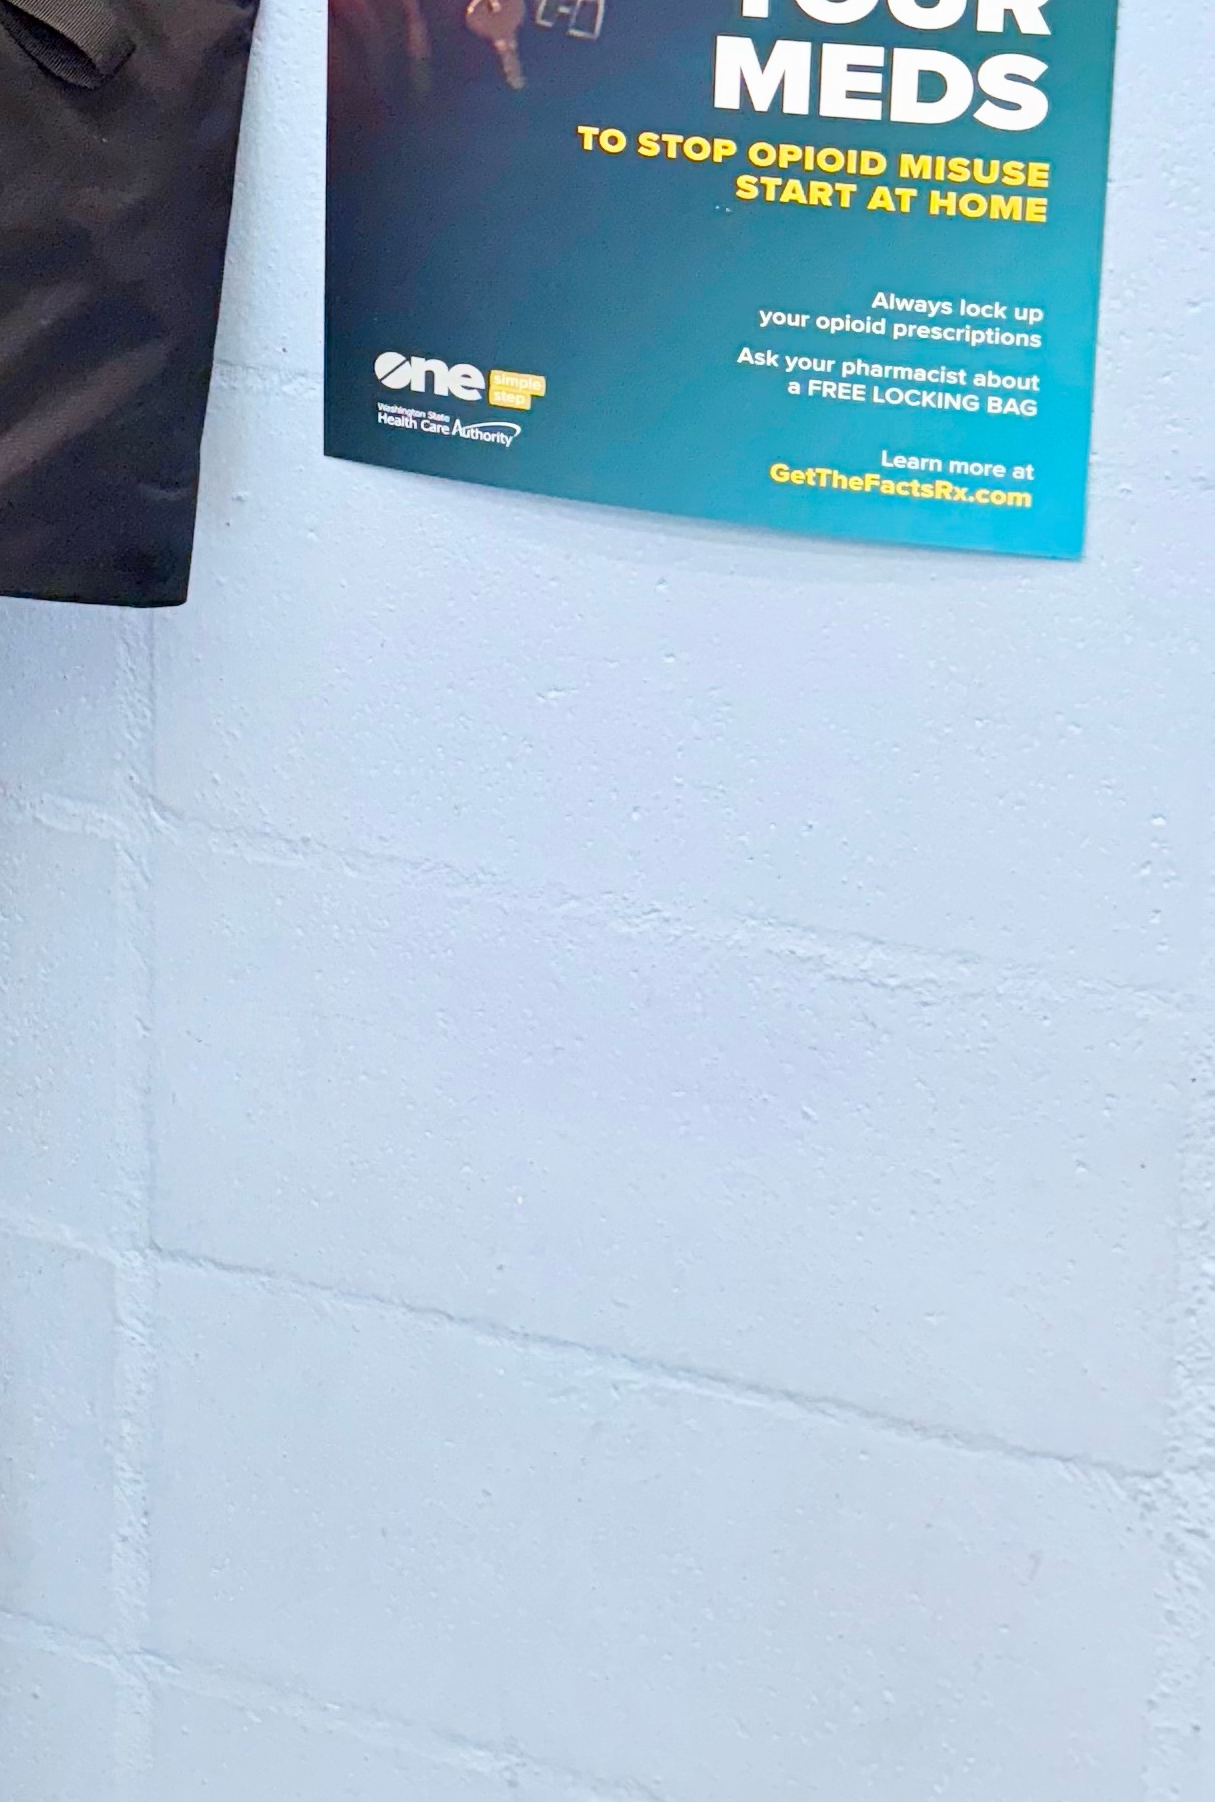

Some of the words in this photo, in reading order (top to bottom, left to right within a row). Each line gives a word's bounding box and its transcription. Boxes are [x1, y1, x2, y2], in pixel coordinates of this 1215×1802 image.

[714, 35, 1049, 131] MEDS
[576, 125, 627, 154] TO
[637, 131, 737, 163] STOP
[747, 141, 887, 176] OPIOID
[899, 153, 1050, 188] MISUSE
[734, 174, 857, 208] START
[866, 186, 918, 212] AT
[928, 191, 1048, 223] HOME
[871, 292, 953, 319] Always
[960, 298, 1007, 320] lock
[1014, 306, 1044, 325] up
[759, 309, 810, 328] your
[815, 314, 886, 334] opioid
[892, 322, 1042, 348] prescriptions
[374, 351, 486, 401] one
[492, 372, 542, 391] simple
[737, 347, 779, 367] Ask
[785, 354, 835, 373] your
[841, 359, 967, 386] pharmacist
[972, 370, 1041, 392] about
[377, 402, 426, 419] Washington
[427, 408, 451, 423] State
[492, 390, 526, 405] step
[787, 381, 801, 395] a
[807, 379, 866, 402] FREE
[872, 386, 980, 412] LOCKING
[986, 396, 1038, 417] BAG
[377, 412, 418, 430] Health
[420, 419, 450, 435] Care
[451, 419, 516, 447] Authority
[881, 450, 943, 472] Learn
[948, 461, 1006, 478] more
[1012, 464, 1035, 481] at
[769, 463, 1032, 507] GetTheFactsRx.com
